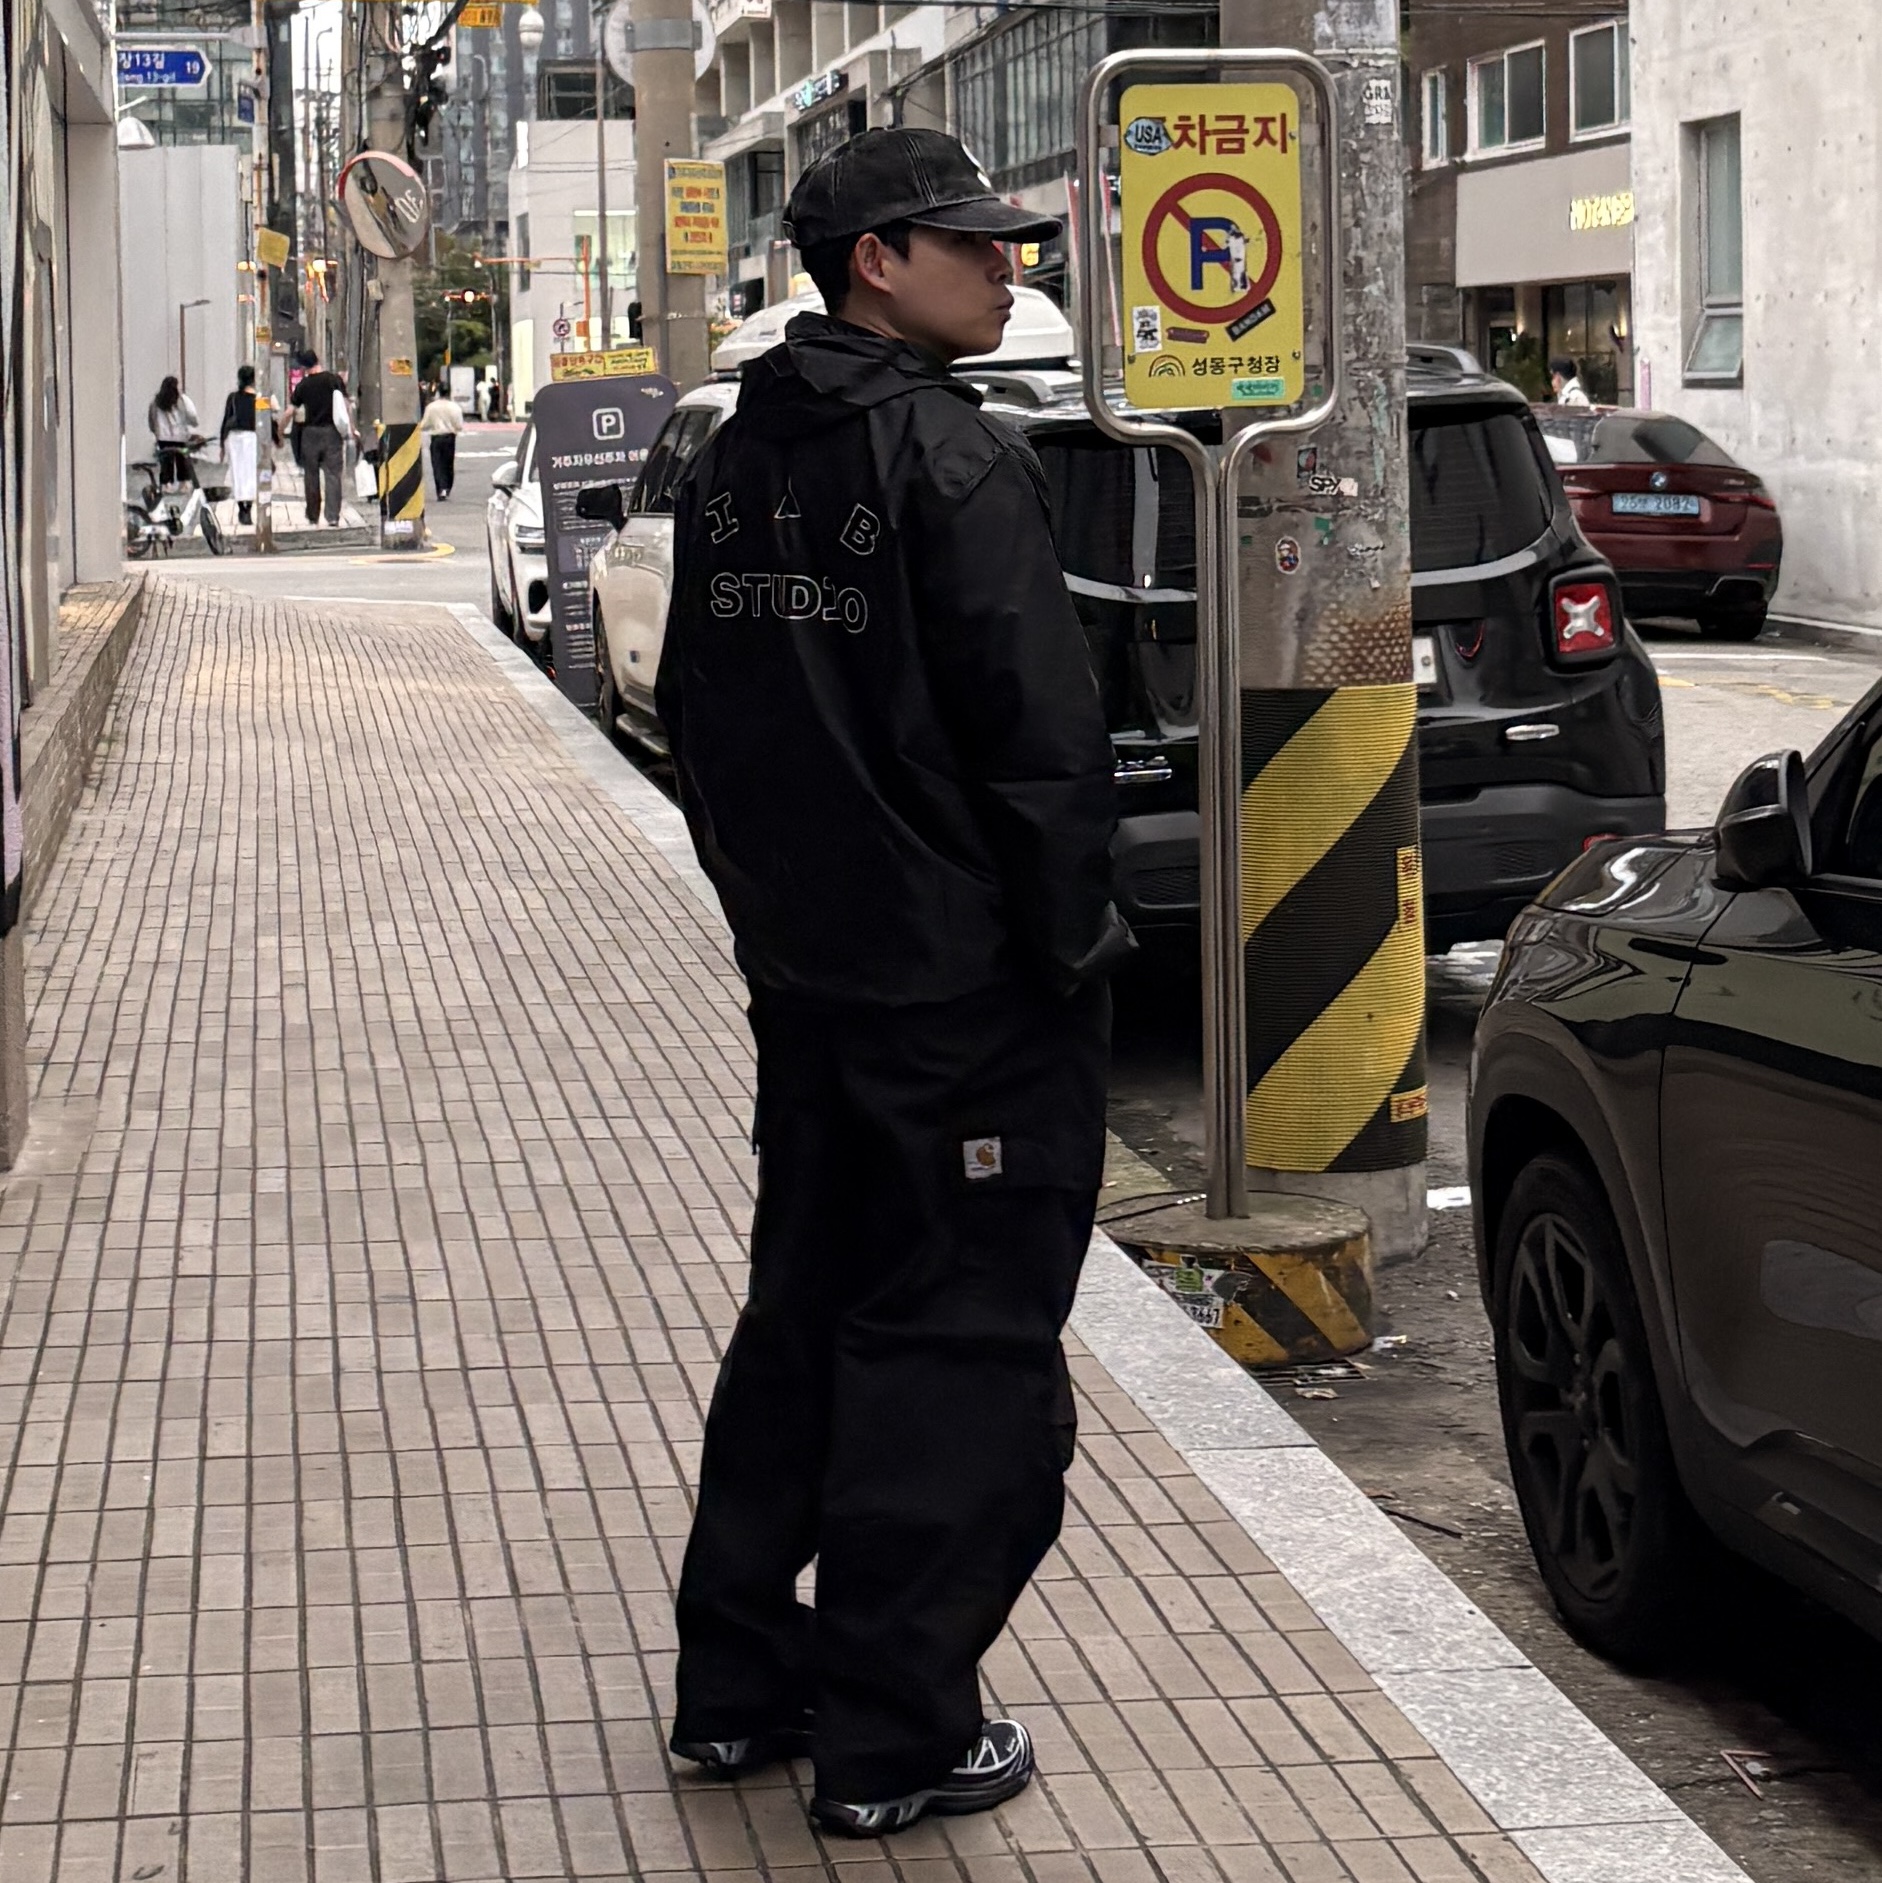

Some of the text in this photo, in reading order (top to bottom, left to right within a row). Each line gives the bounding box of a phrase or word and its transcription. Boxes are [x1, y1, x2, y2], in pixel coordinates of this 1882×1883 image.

[185, 61, 200, 75] 19
[1134, 123, 1163, 144] USA
[1140, 112, 1288, 156] 차금지
